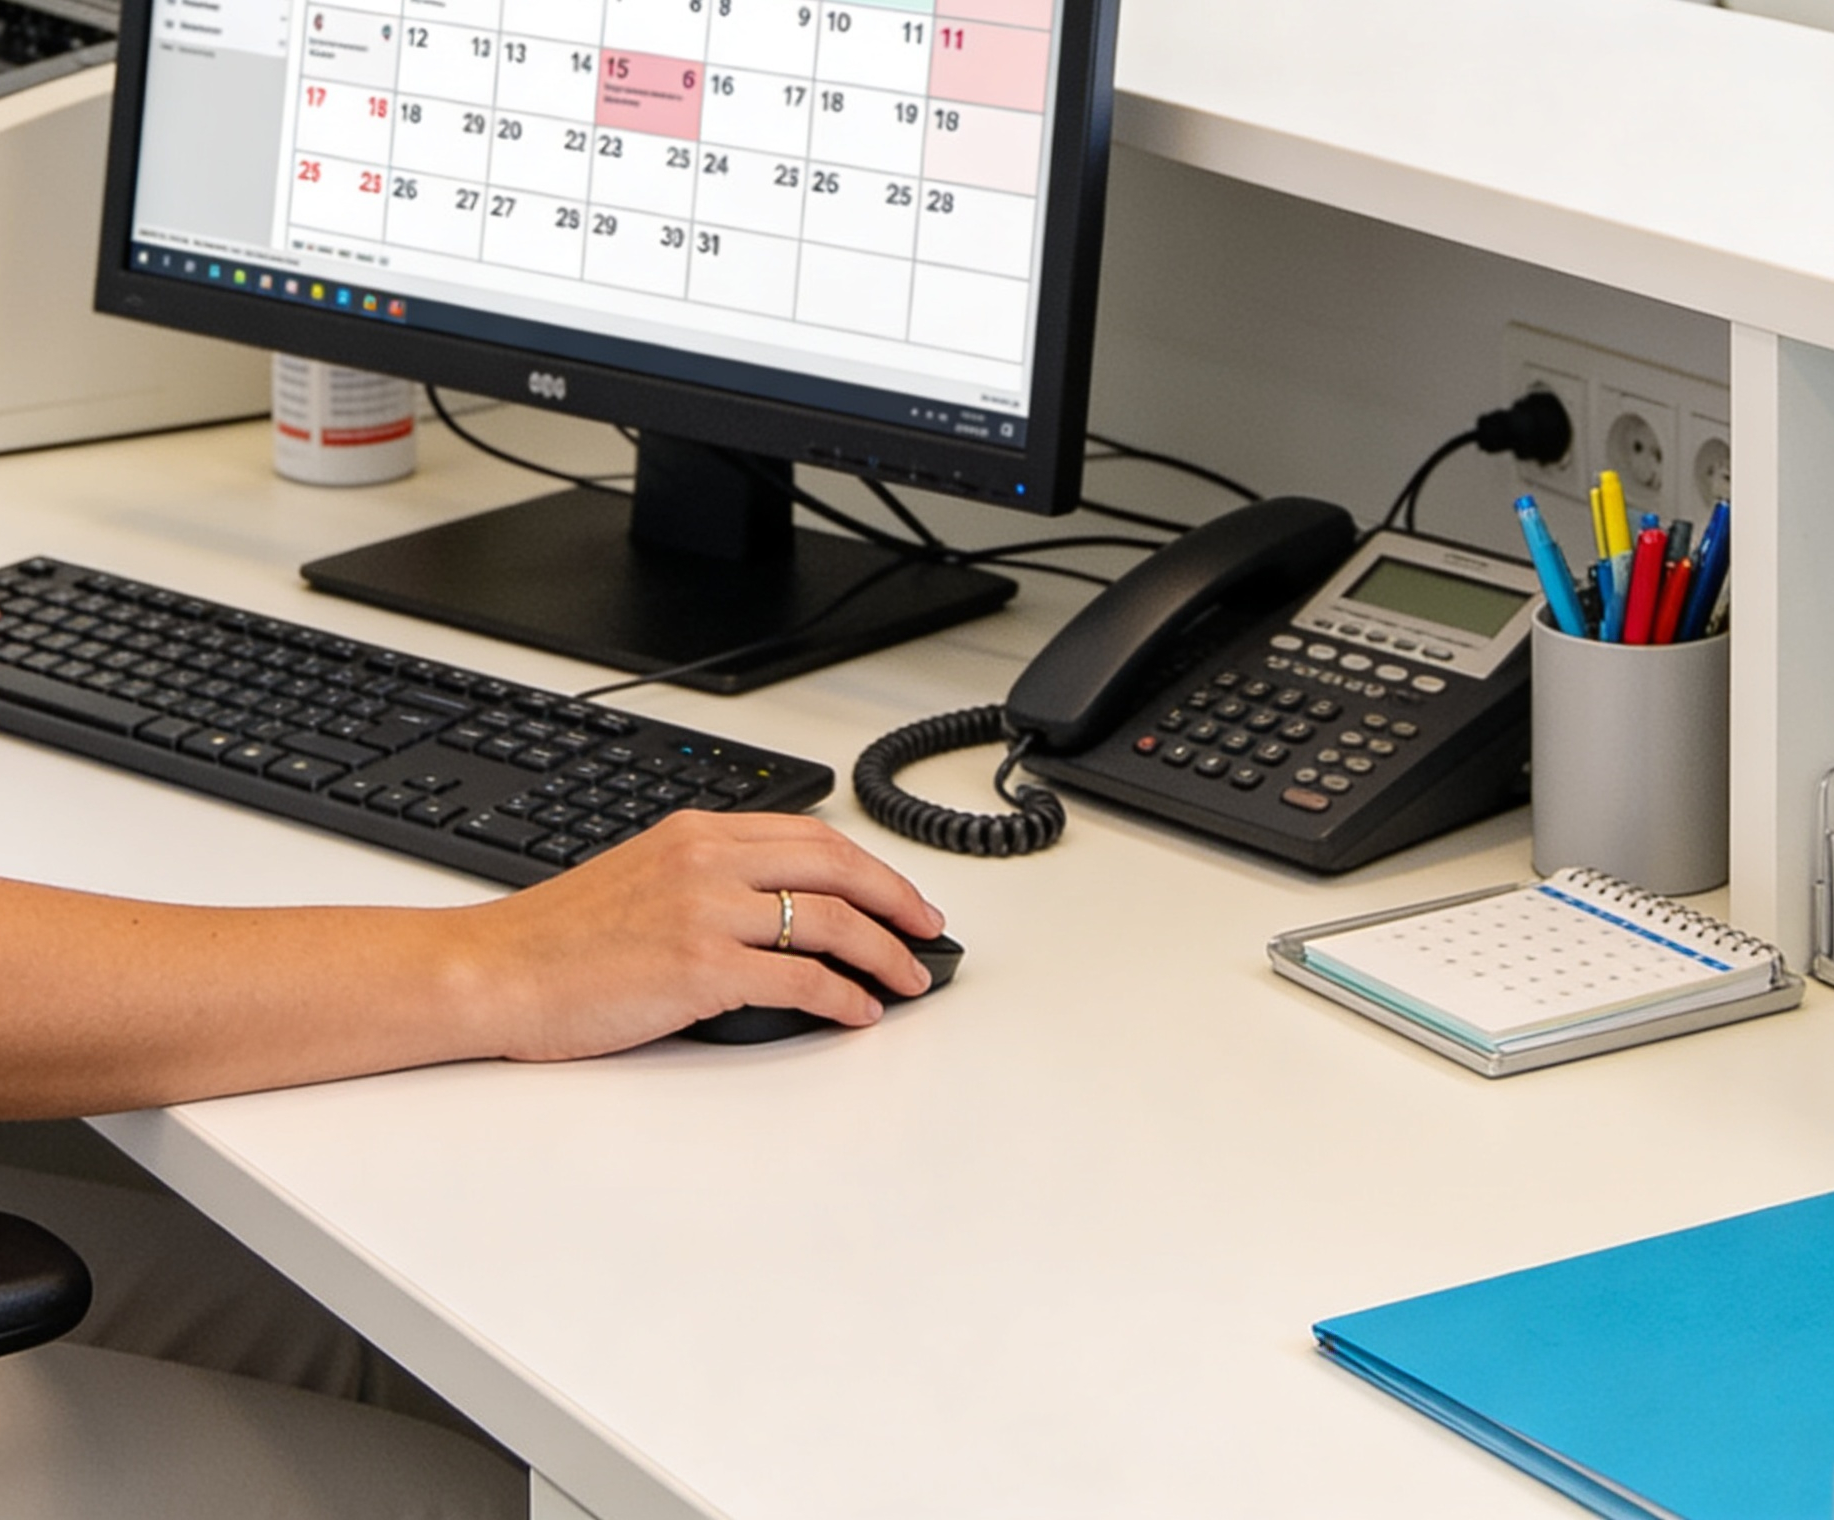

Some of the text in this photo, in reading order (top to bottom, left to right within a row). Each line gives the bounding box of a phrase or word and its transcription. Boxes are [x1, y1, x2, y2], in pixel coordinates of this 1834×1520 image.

[798, 6, 812, 27] 9
[827, 11, 852, 33] 10
[407, 27, 429, 48] 12
[903, 21, 924, 45] 11
[941, 28, 964, 50] 11
[607, 57, 629, 79] 15
[306, 86, 327, 106] 17
[711, 74, 734, 96] 16
[784, 85, 807, 106] 17
[821, 90, 844, 113] 18
[895, 102, 919, 125] 19
[392, 177, 418, 200] 26
[455, 188, 480, 211] 27
[490, 195, 516, 217] 27
